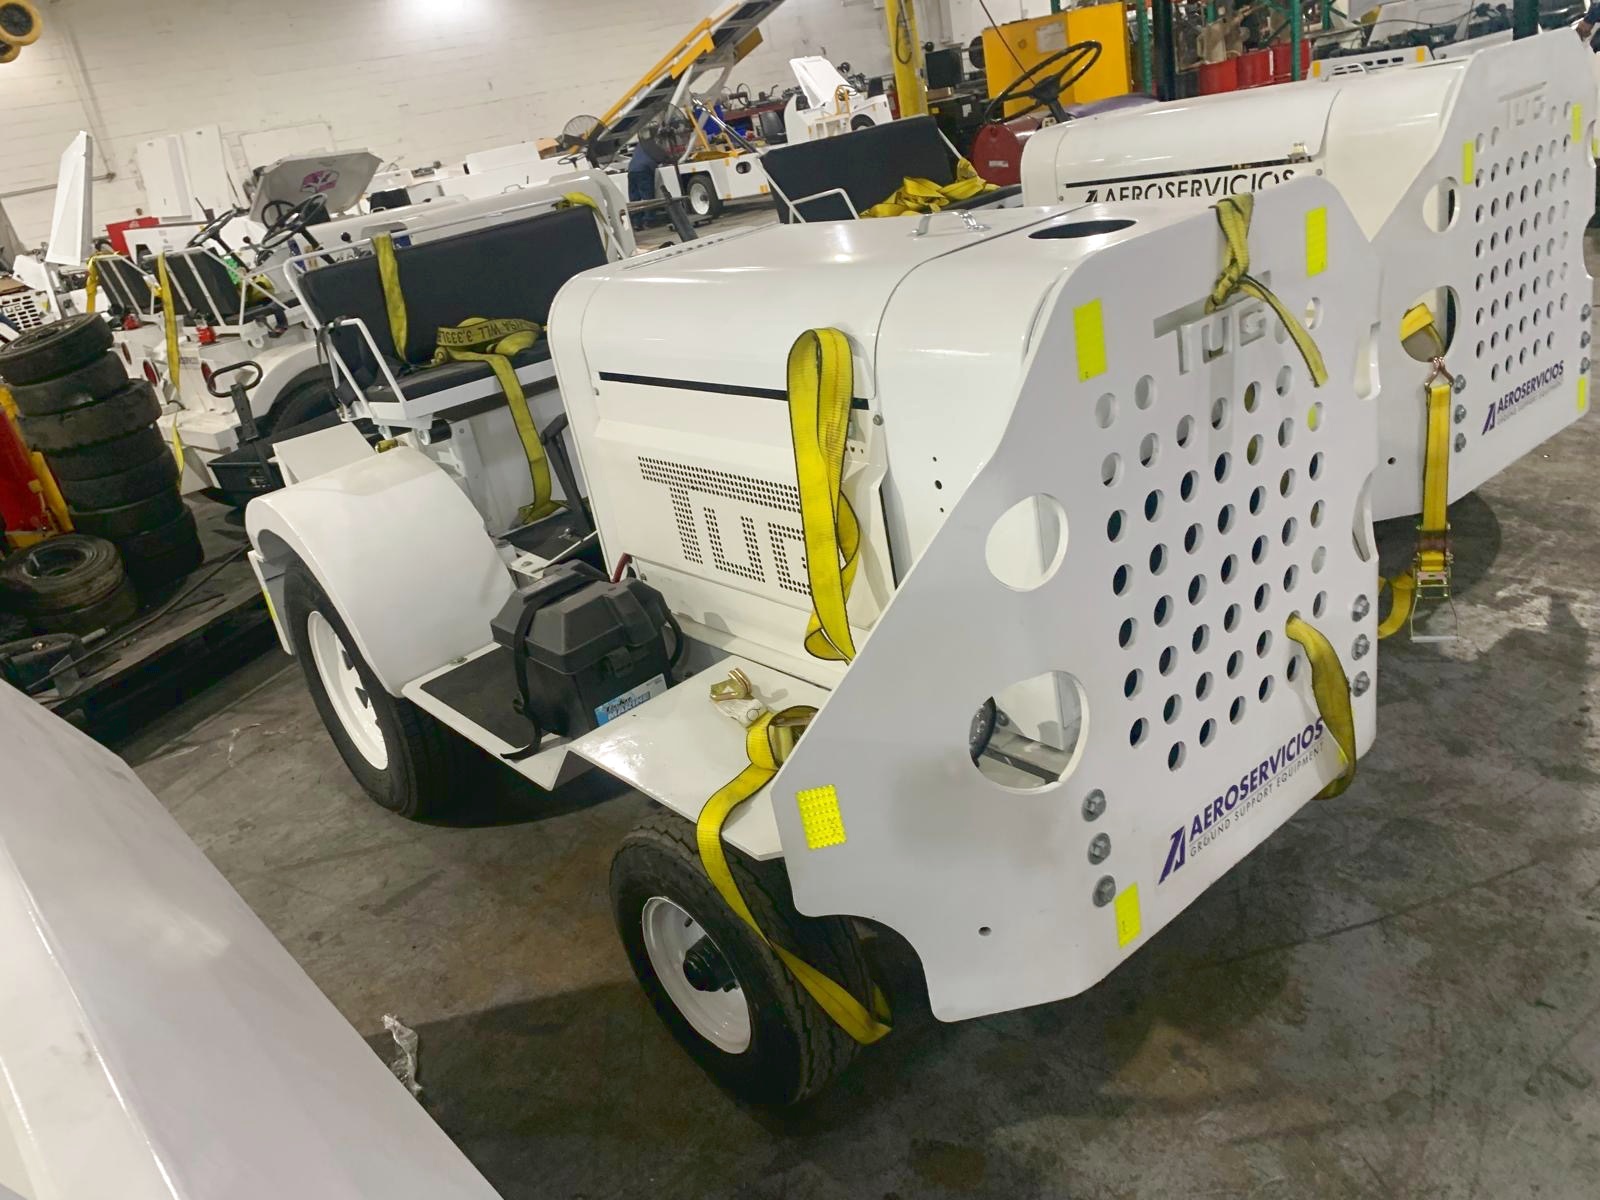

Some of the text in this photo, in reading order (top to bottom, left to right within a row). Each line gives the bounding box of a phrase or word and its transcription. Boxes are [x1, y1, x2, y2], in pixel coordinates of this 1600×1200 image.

[1153, 270, 1271, 376] TUG
[1497, 360, 1564, 414] AEROSERVICIOS
[1190, 716, 1324, 842] AEROSERVICIOS
[1190, 741, 1325, 857] GROUND SUPPORT EQUIPMENT
